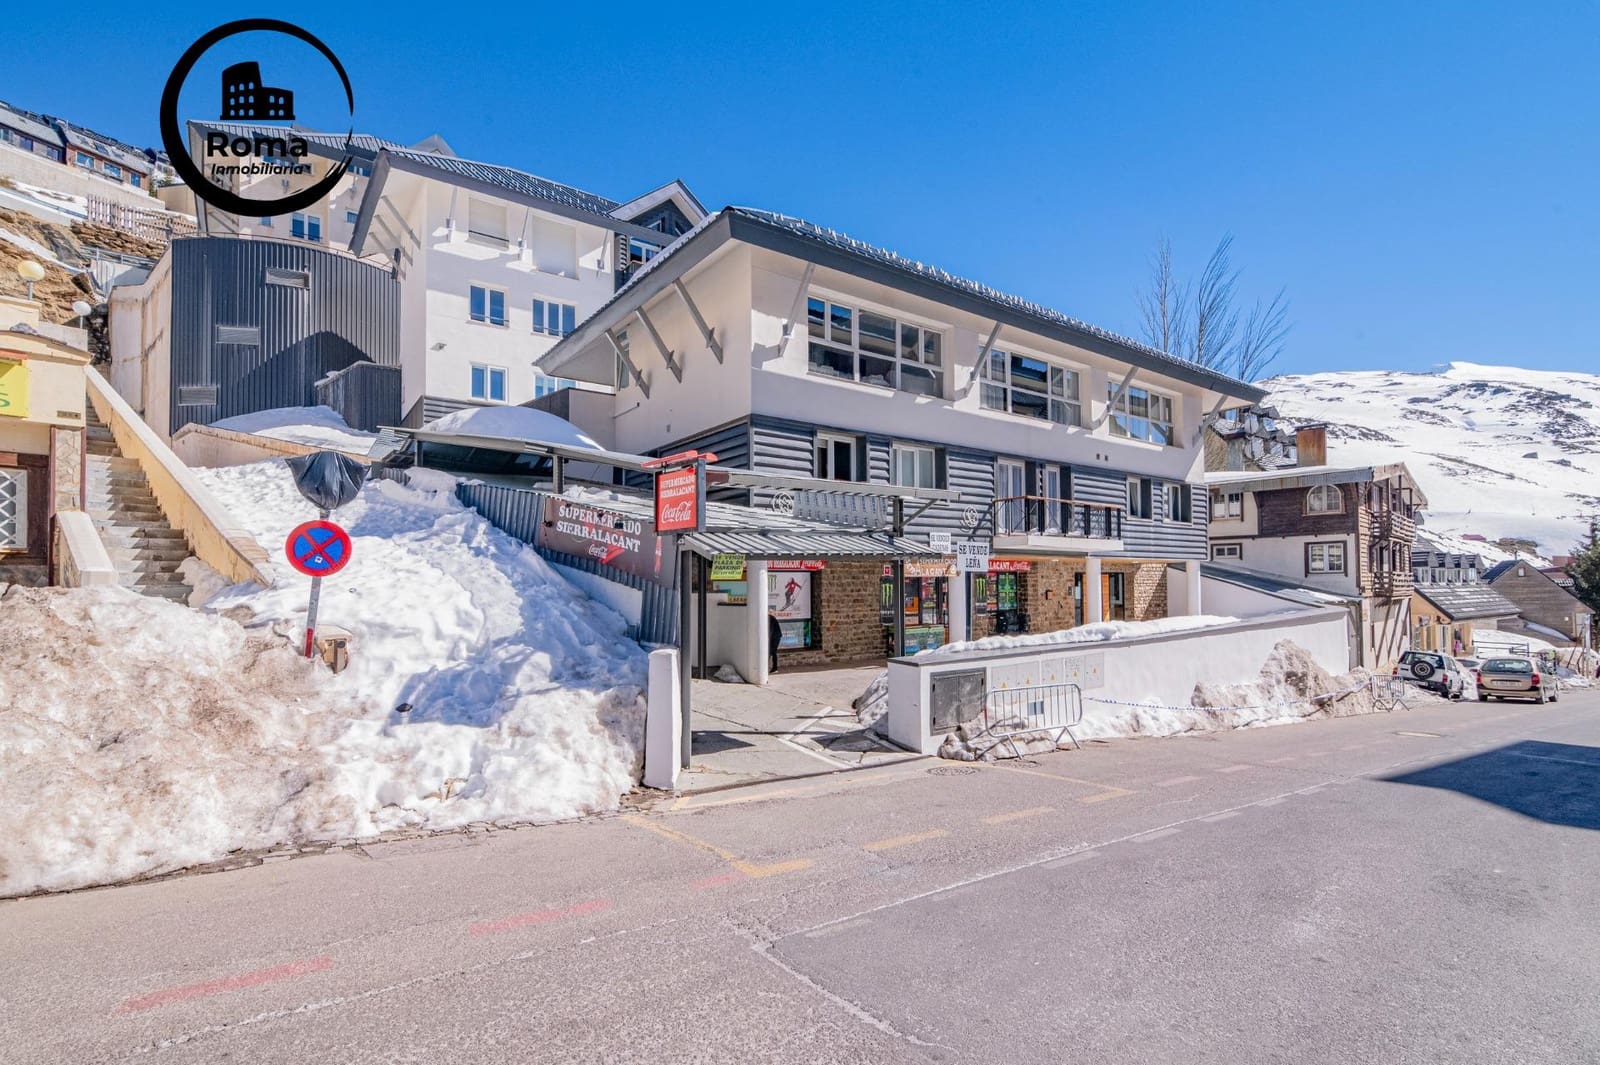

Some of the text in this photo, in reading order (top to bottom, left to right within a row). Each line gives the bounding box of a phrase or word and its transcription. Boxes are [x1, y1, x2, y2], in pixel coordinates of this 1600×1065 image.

[556, 520, 641, 553] SIERRALACANT
[958, 544, 967, 555] SE
[968, 544, 989, 555] VENDE
[965, 556, 981, 568] LEÑA
